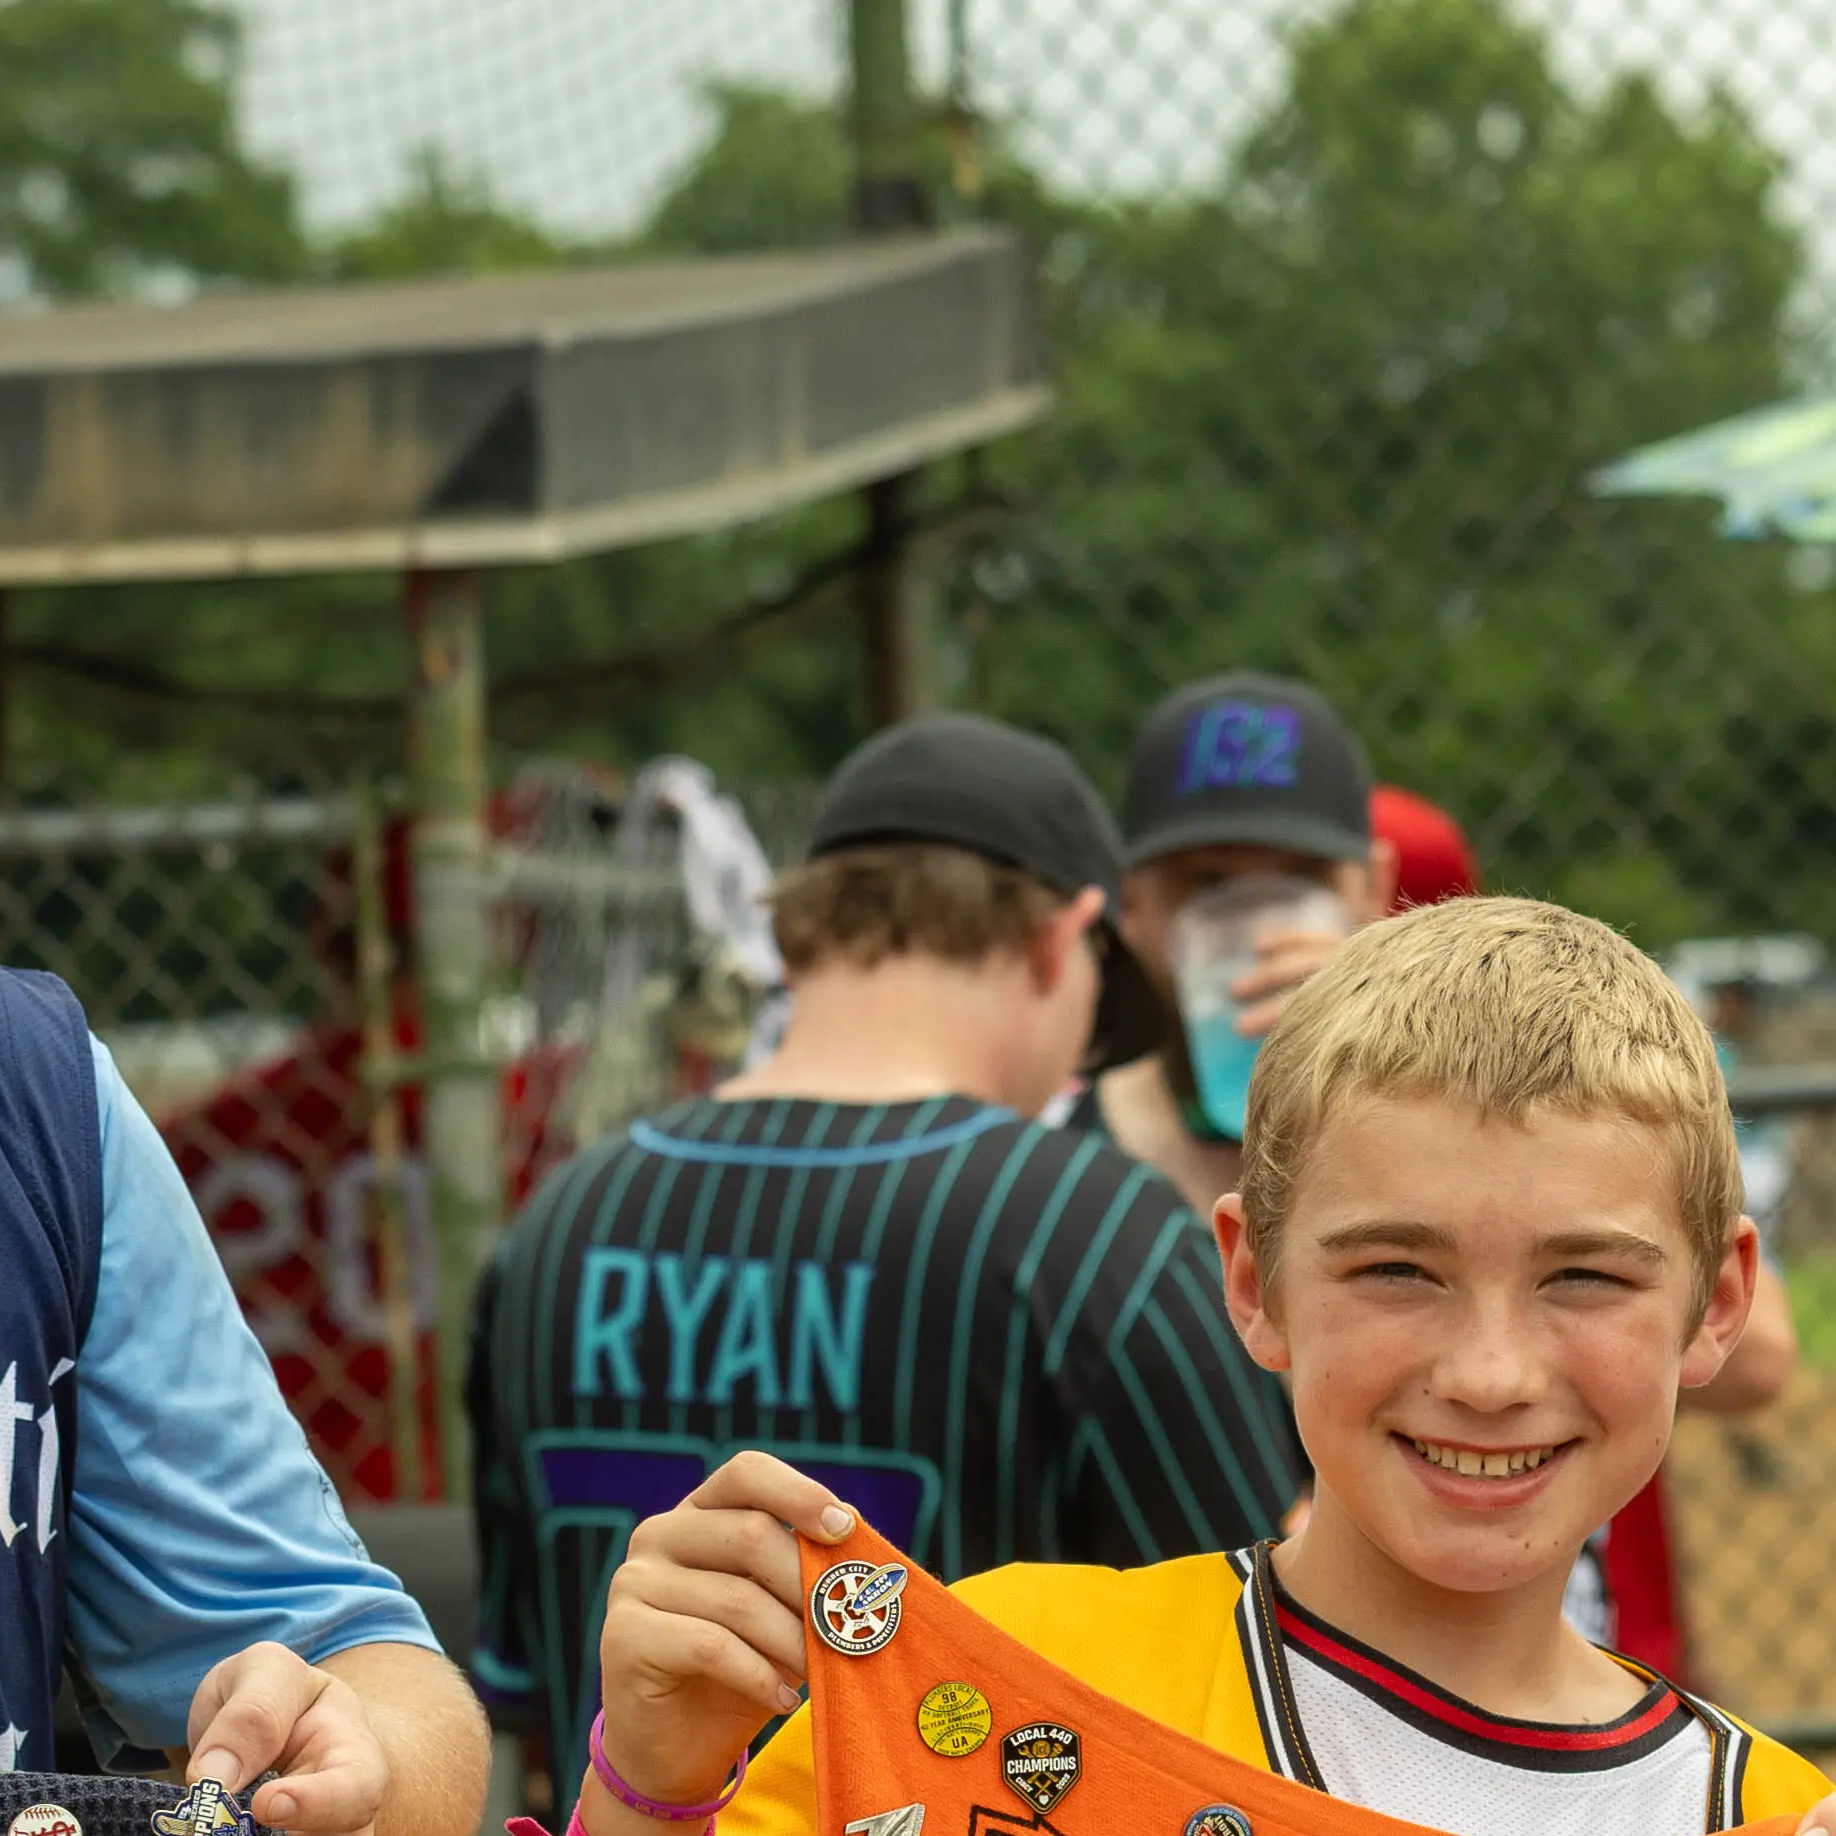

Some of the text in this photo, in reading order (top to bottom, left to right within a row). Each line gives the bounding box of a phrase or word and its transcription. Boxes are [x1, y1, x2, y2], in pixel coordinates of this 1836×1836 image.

[573, 1248, 871, 1411] RYAN
[848, 1564, 869, 1575] CITY
[827, 1631, 865, 1650] PLUMBERS
[941, 1691, 958, 1704] 98
[954, 1683, 975, 1695] LOCAL
[951, 1736, 969, 1749] UA
[1010, 1728, 1073, 1747] LOCAL 440
[1006, 1756, 1076, 1774] CHAMPIONS
[1015, 1774, 1034, 1794] CINCY
